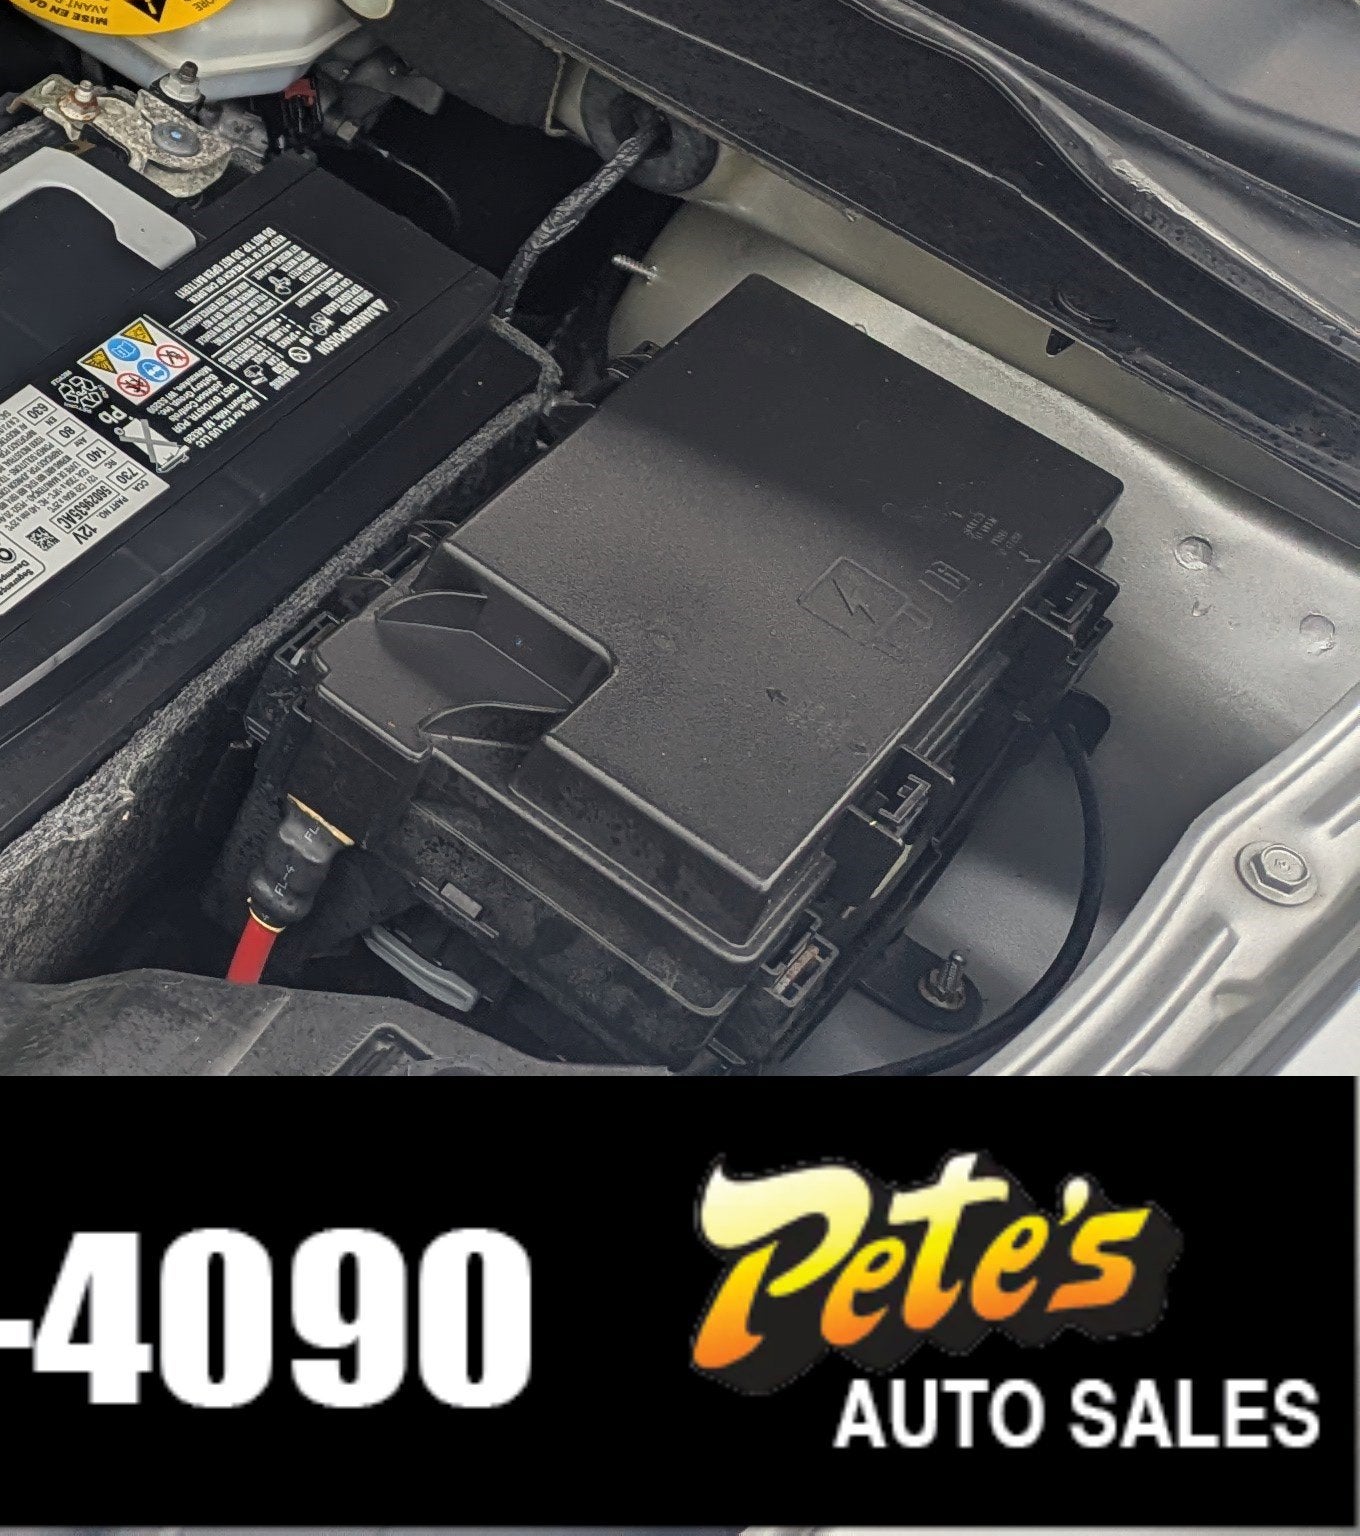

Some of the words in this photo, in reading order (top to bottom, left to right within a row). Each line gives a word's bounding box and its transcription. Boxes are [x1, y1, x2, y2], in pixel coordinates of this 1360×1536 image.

[50, 5, 69, 17] EN
[66, 0, 108, 14] AVANT
[72, 12, 108, 26] MISE
[187, 371, 219, 394] Battery
[216, 381, 240, 399] DIST.
[192, 379, 226, 403] Johnson
[184, 394, 224, 423] BY/DISTR.
[225, 390, 254, 411] Auburn
[25, 401, 49, 419] 630
[98, 404, 128, 424] Pb
[167, 399, 200, 423] Controls
[230, 409, 247, 421] for
[44, 415, 57, 425] EN
[169, 417, 192, 434] POR
[217, 416, 237, 431] FCA
[56, 424, 76, 439] 80
[207, 426, 224, 439] US
[193, 434, 214, 449] LLC
[84, 445, 107, 462] 140
[103, 458, 117, 469] RC
[113, 466, 139, 485] 730
[131, 479, 150, 492] CCA
[54, 484, 115, 530] 56029635AC
[107, 495, 129, 511] PART
[95, 507, 112, 520] NO.
[68, 521, 100, 545] 12V
